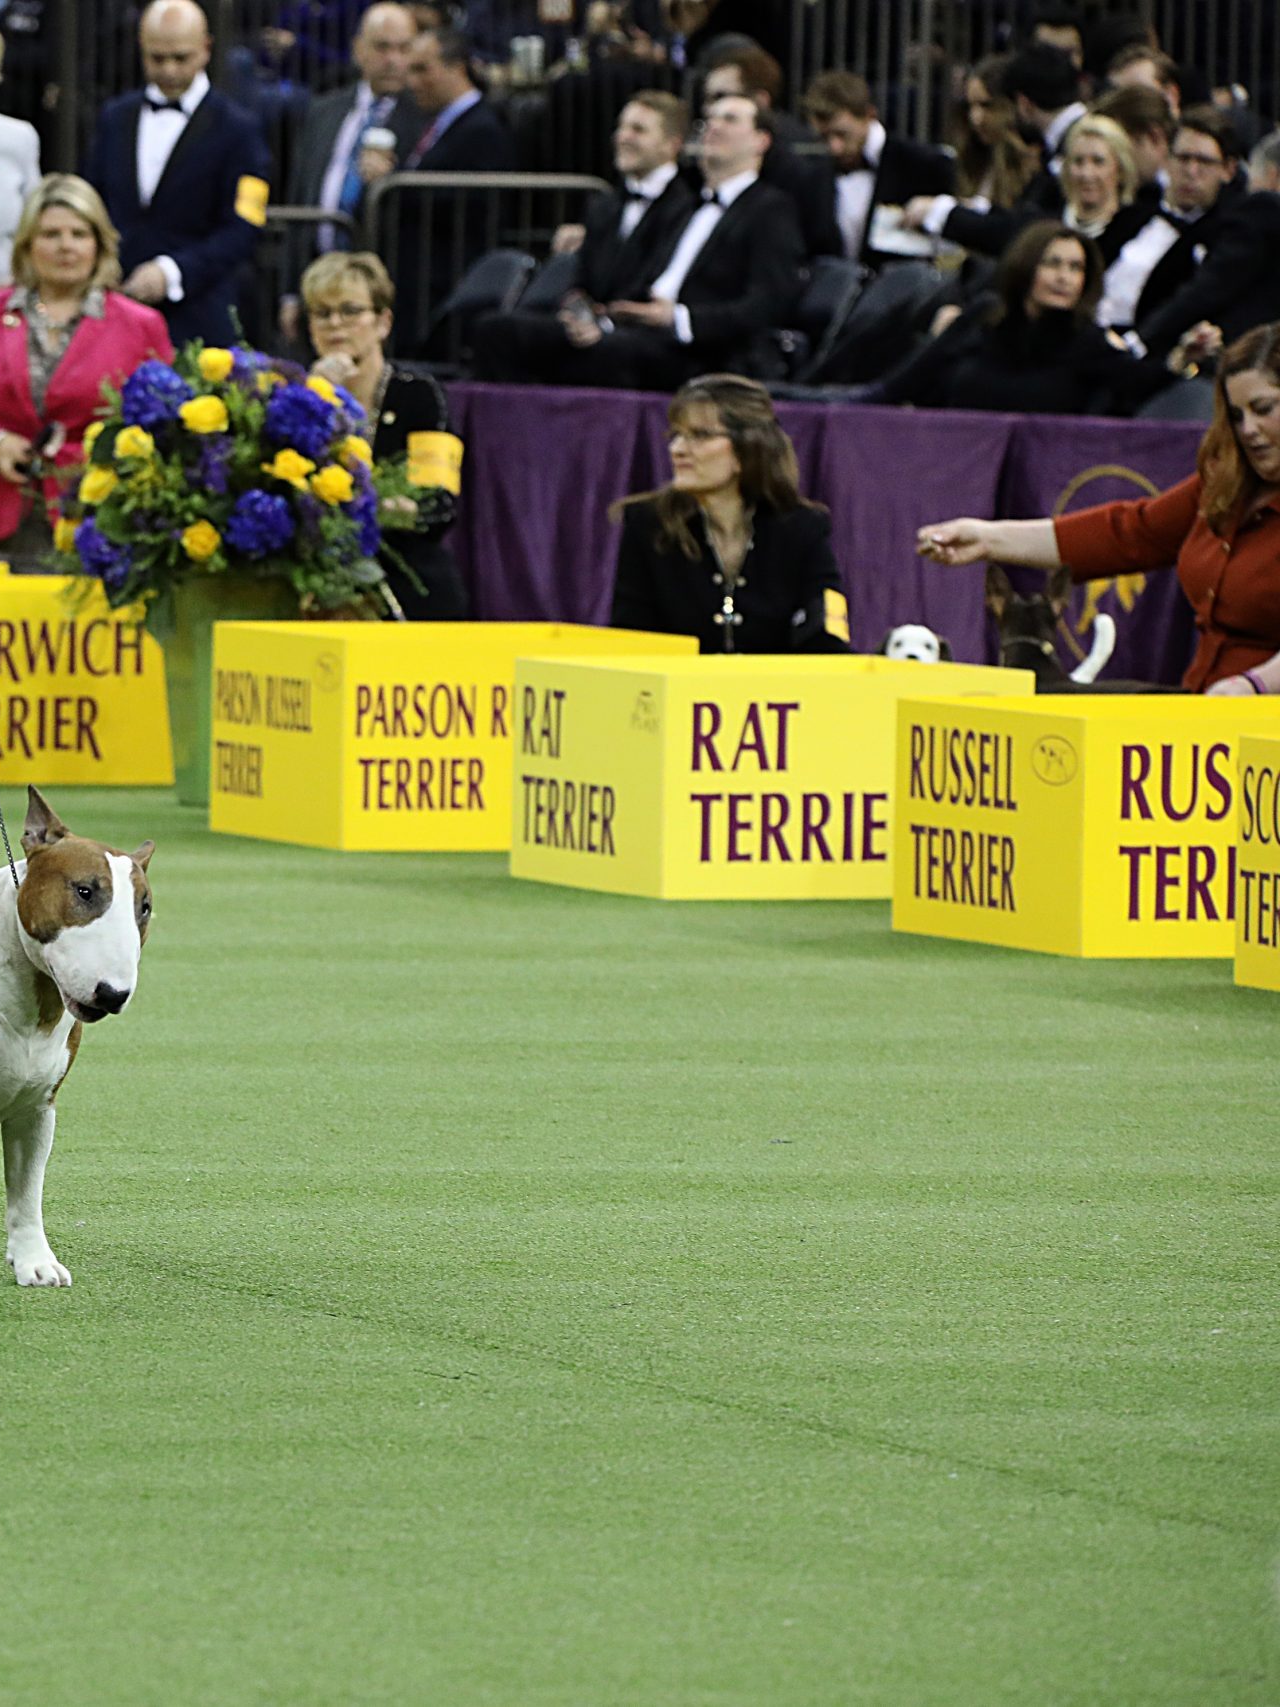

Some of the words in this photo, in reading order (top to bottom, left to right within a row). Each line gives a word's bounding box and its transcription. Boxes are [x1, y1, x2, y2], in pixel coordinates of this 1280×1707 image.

[216, 668, 262, 727] PARSON
[265, 674, 314, 734] RUSSELL
[354, 683, 477, 739] PARSON
[521, 685, 567, 760] RAT
[690, 701, 800, 773] RAT
[215, 739, 264, 799] TERRIER
[358, 757, 486, 812] TERRIER
[909, 723, 1018, 812] RUSSELL
[1119, 742, 1233, 822] RUS
[521, 774, 617, 858] TERRIER
[690, 791, 889, 863] TERRIE
[909, 822, 1017, 913] TERRIER
